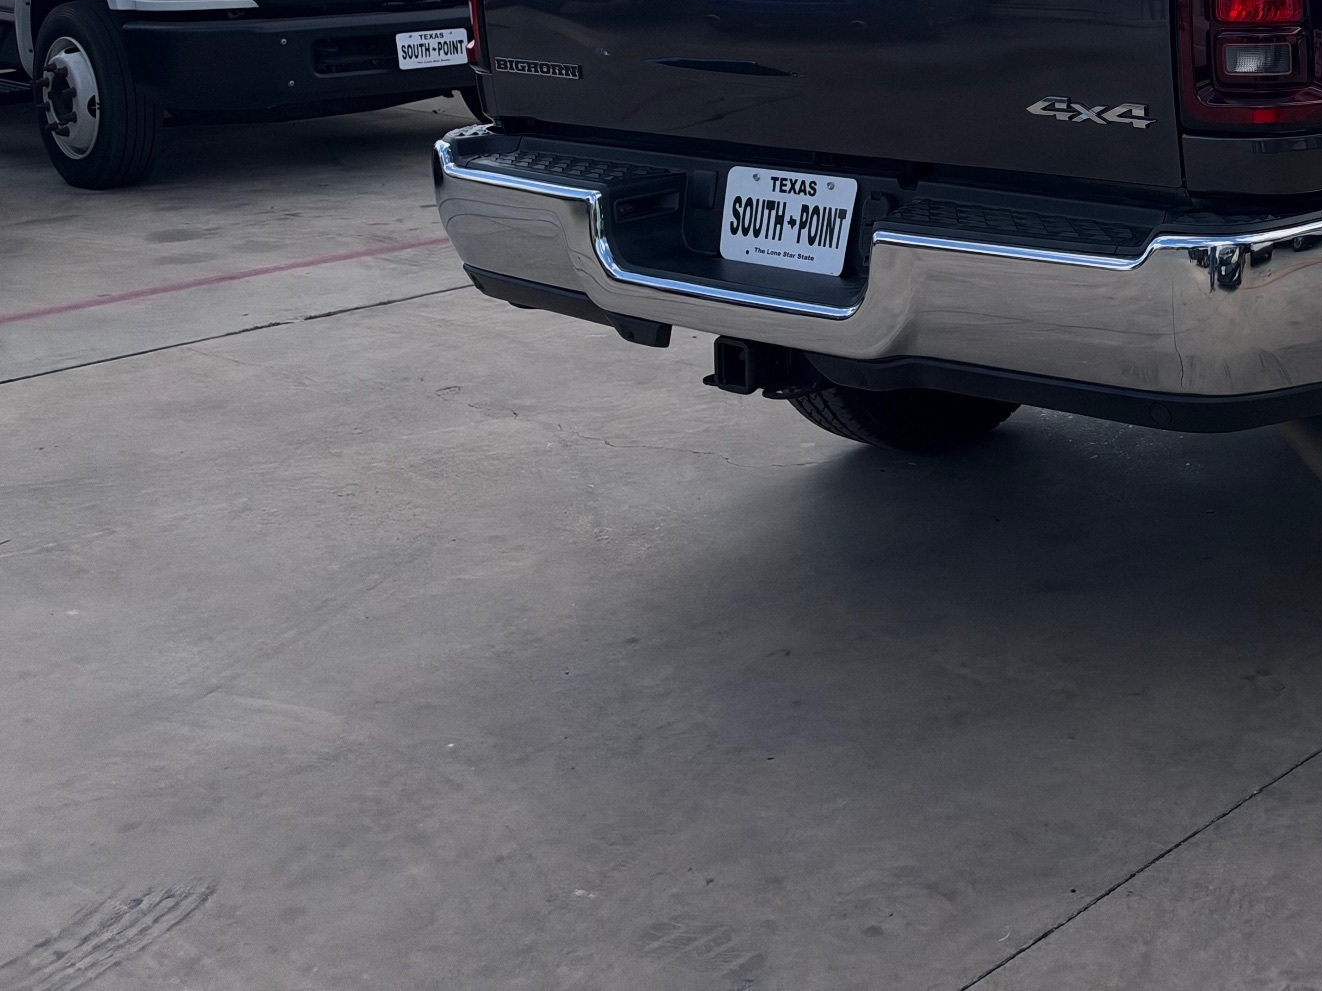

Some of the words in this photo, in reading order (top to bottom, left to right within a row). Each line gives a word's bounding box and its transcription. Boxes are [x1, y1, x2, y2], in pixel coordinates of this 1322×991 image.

[419, 32, 445, 41] TEXAS
[401, 42, 431, 61] SOUTH
[437, 39, 465, 57] POINT
[495, 56, 583, 80] BIGHORN
[770, 176, 818, 197] TEXAS
[729, 195, 787, 242] SOUTH
[796, 203, 848, 250] POINT
[754, 247, 766, 255] The
[767, 249, 782, 257] Lone
[782, 251, 796, 259] Star
[797, 253, 815, 262] State
